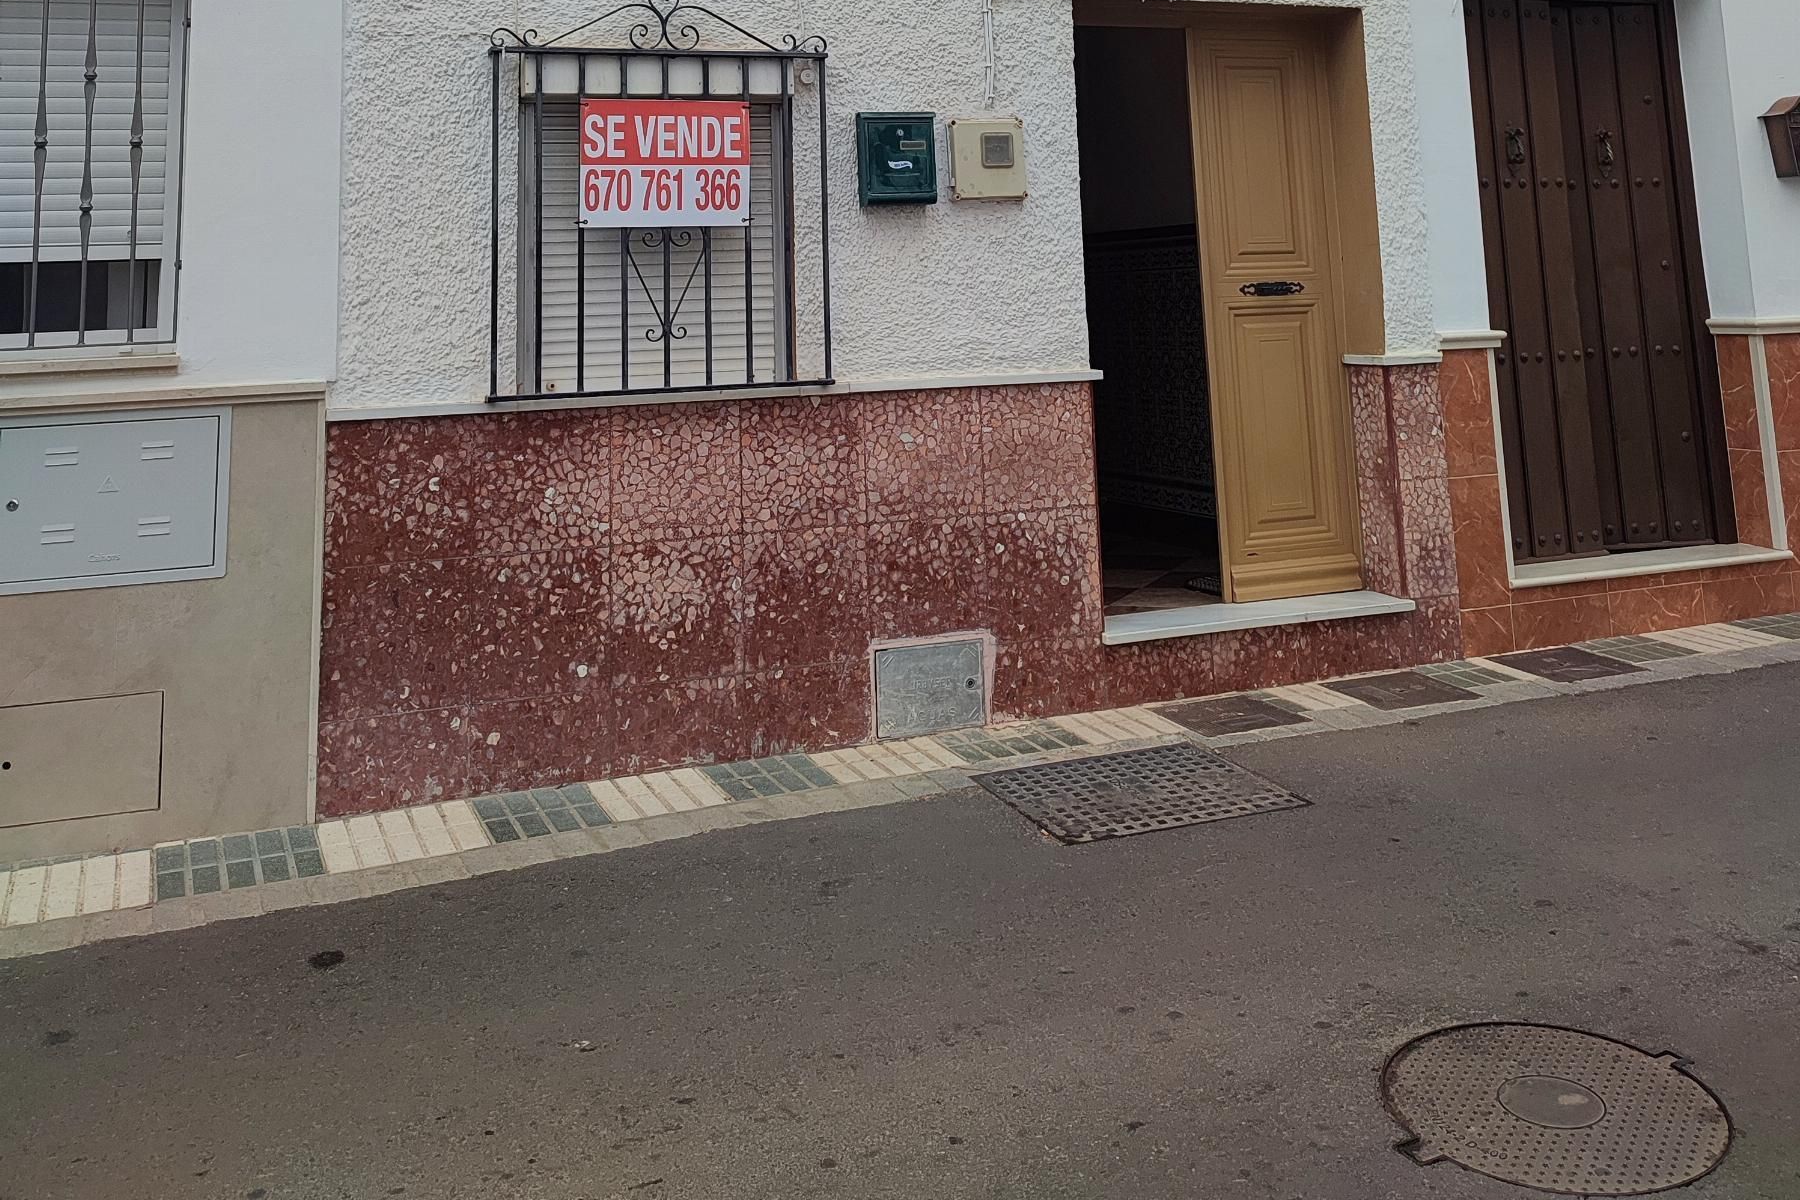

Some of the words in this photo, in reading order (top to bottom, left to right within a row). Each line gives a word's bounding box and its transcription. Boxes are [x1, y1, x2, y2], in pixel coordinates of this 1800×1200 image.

[584, 114, 626, 159] SE
[634, 115, 742, 158] VENDE
[584, 168, 632, 212] 670
[640, 168, 683, 211] 761
[695, 168, 741, 212] 366
